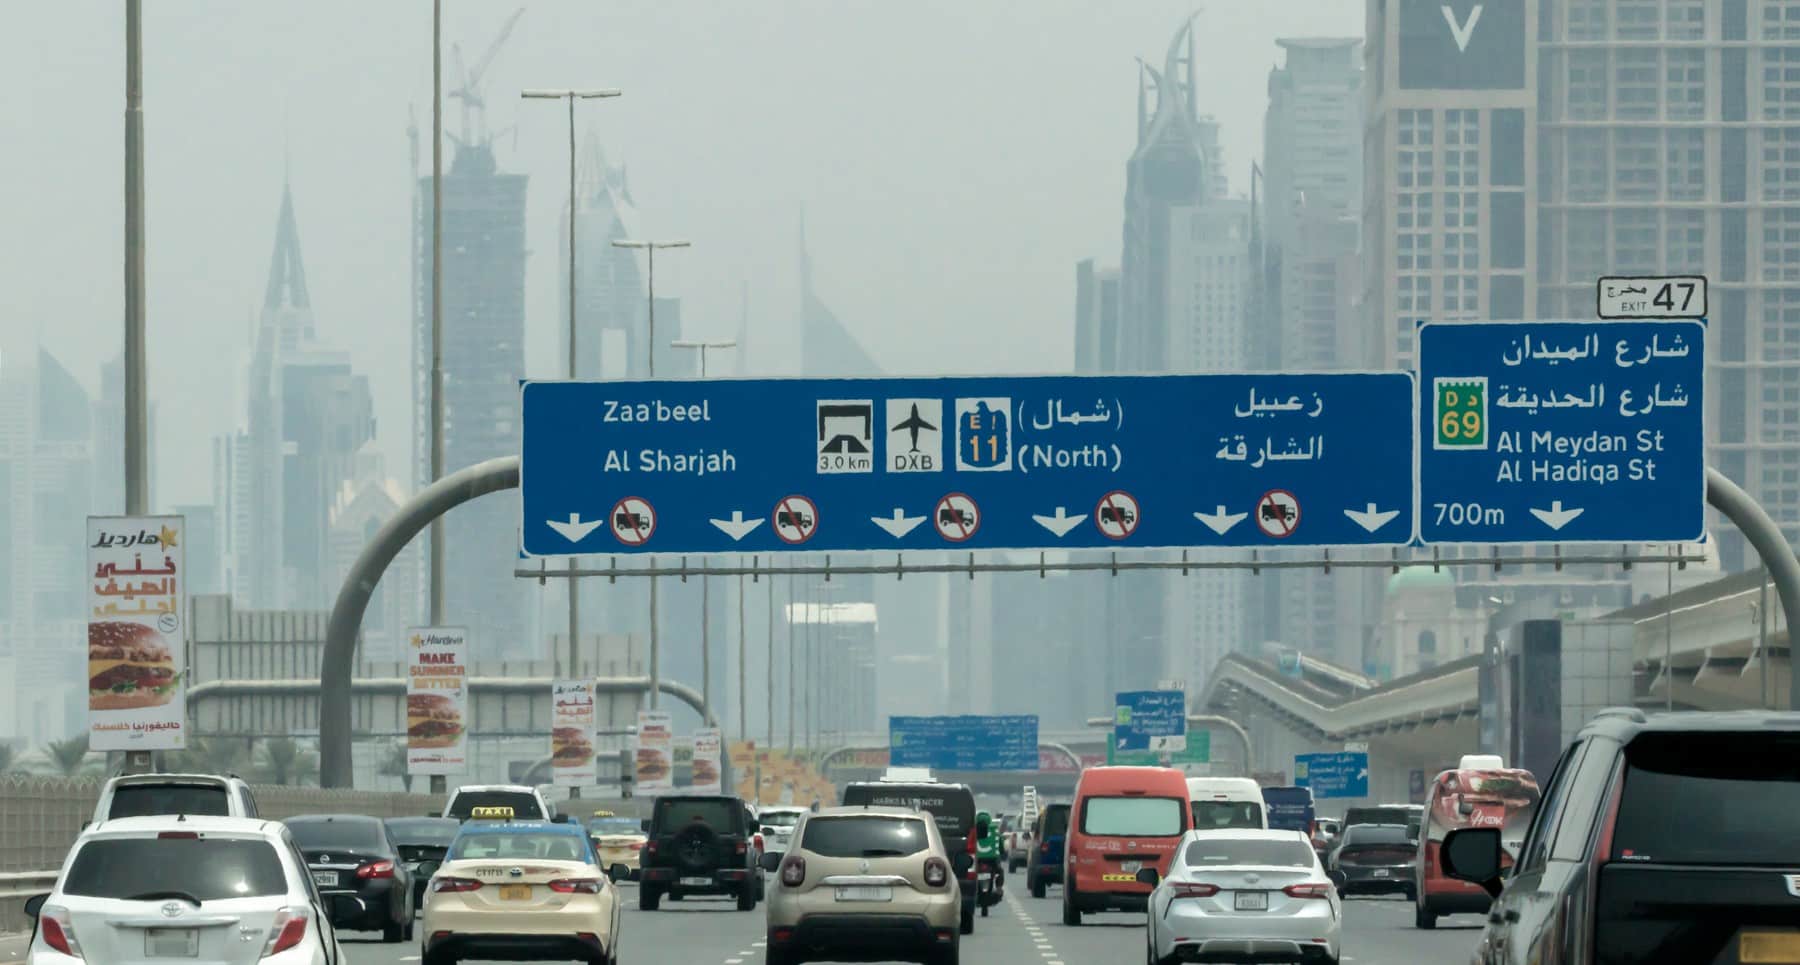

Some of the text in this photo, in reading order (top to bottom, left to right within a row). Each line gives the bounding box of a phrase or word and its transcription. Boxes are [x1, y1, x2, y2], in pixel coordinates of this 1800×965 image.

[1607, 284, 1647, 298] مخرج
[1652, 283, 1696, 311] 47
[1621, 301, 1648, 312] EXIT
[1502, 332, 1690, 367] شارع الميدان
[1234, 386, 1323, 419] زعبيل
[1445, 390, 1459, 407] D
[1496, 381, 1689, 417] شارع الحديقة
[603, 399, 711, 424] Zaa'beel
[969, 414, 981, 430] E
[1441, 410, 1481, 439] 69
[969, 434, 998, 462] 11
[1215, 434, 1323, 468] الشارقة
[1496, 428, 1665, 458] Al Meydan St
[604, 448, 737, 476] Al Sharjah
[819, 455, 870, 471] 3.0 km
[894, 454, 933, 471] DXB
[1018, 443, 1123, 474] (North)
[1496, 458, 1657, 486] Al Hadiqa St
[1433, 502, 1505, 527] 700m
[91, 529, 159, 548] هارديز
[409, 665, 465, 677] SUMMER
[419, 652, 456, 665] MAKE
[478, 806, 508, 817] TAXI
